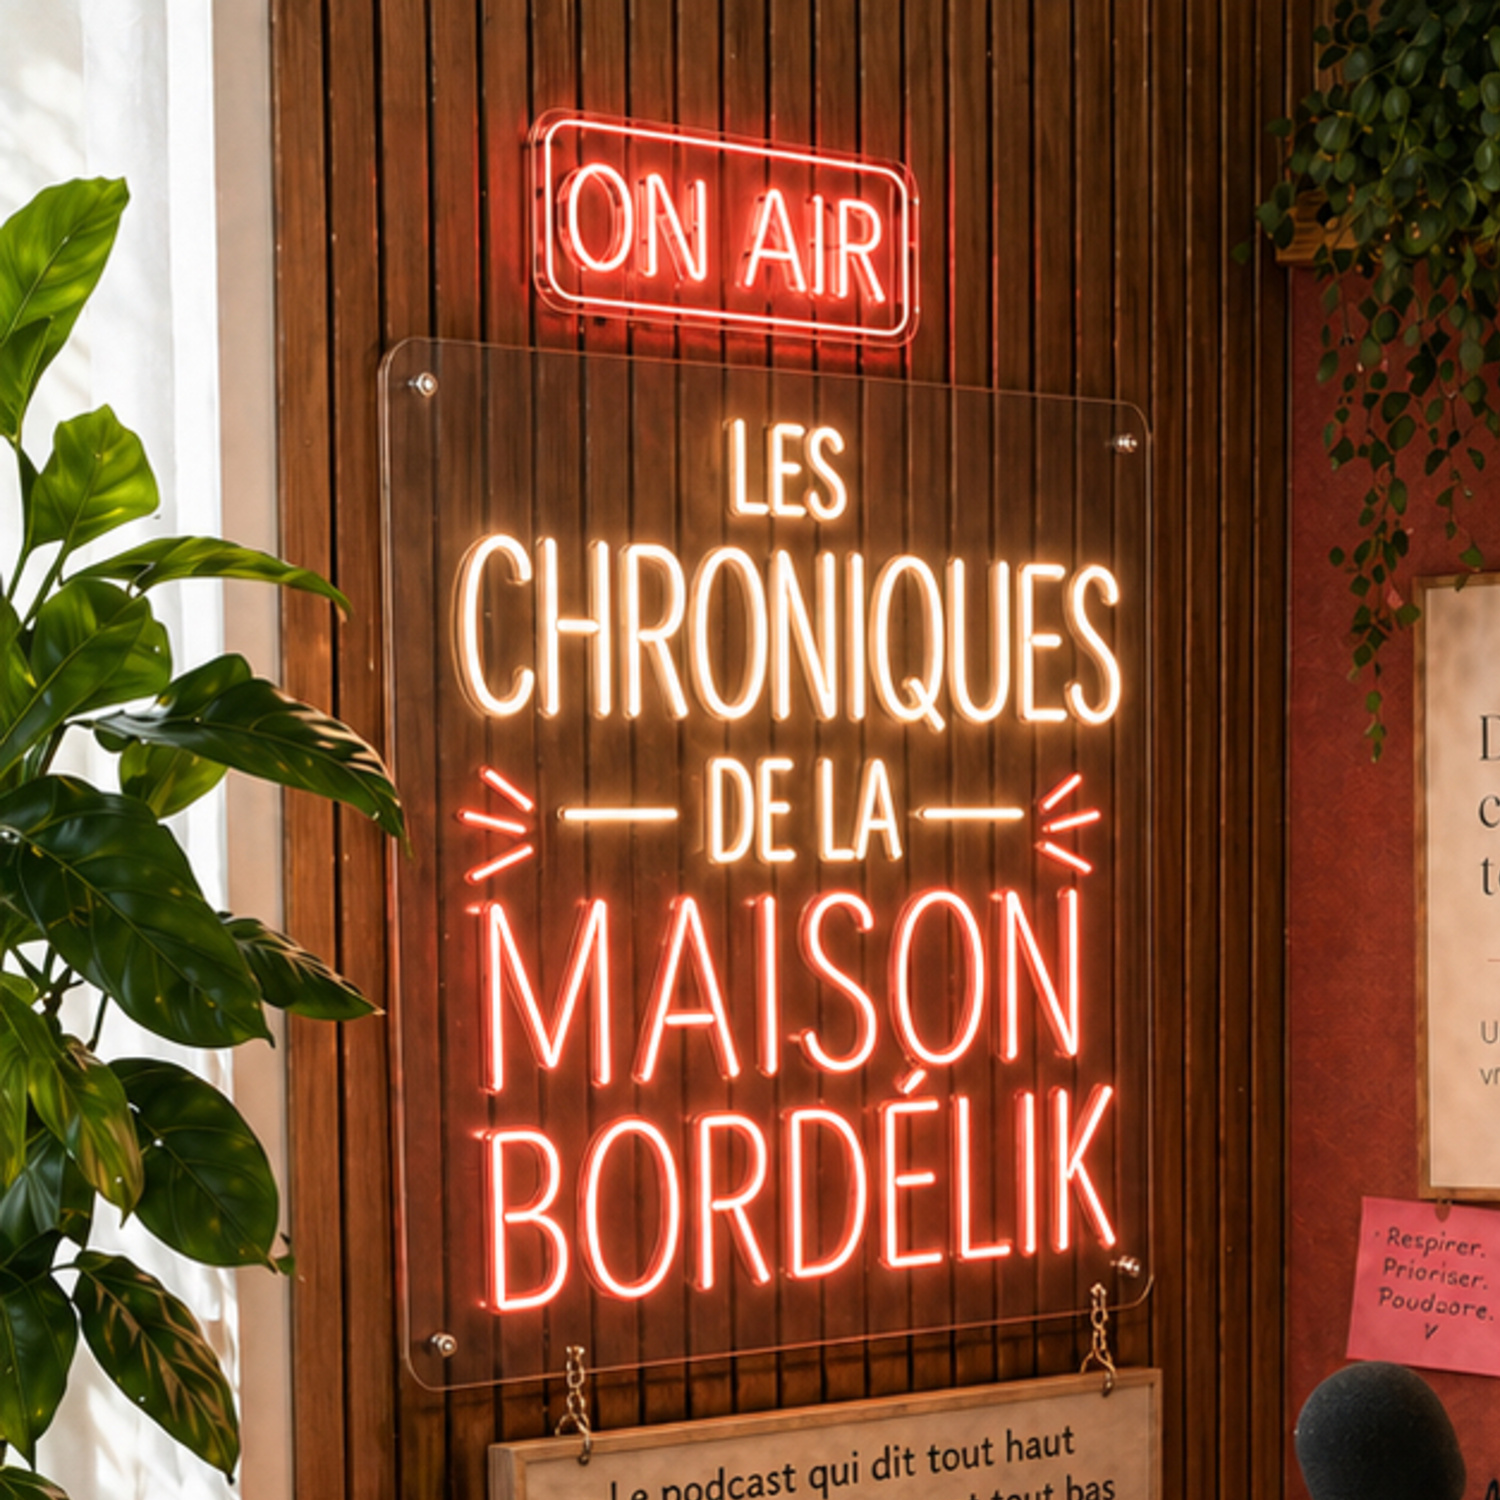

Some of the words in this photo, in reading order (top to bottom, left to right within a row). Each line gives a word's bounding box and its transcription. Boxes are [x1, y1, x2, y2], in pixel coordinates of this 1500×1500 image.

[562, 162, 707, 284] ON
[738, 187, 886, 304] AIR
[727, 418, 848, 520] LES
[455, 533, 1122, 731] CHRONIQUES
[706, 756, 796, 865] DE
[815, 756, 902, 862] LA
[480, 886, 1080, 1095] MAISON
[482, 1068, 1116, 1314] BORDÉLIK
[1387, 1226, 1486, 1258] Respirer.
[1383, 1257, 1488, 1290] Prioriser.
[808, 1451, 859, 1499] qui
[870, 1444, 916, 1481] dit
[926, 1439, 994, 1474] tout
[1005, 1425, 1075, 1465] haut
